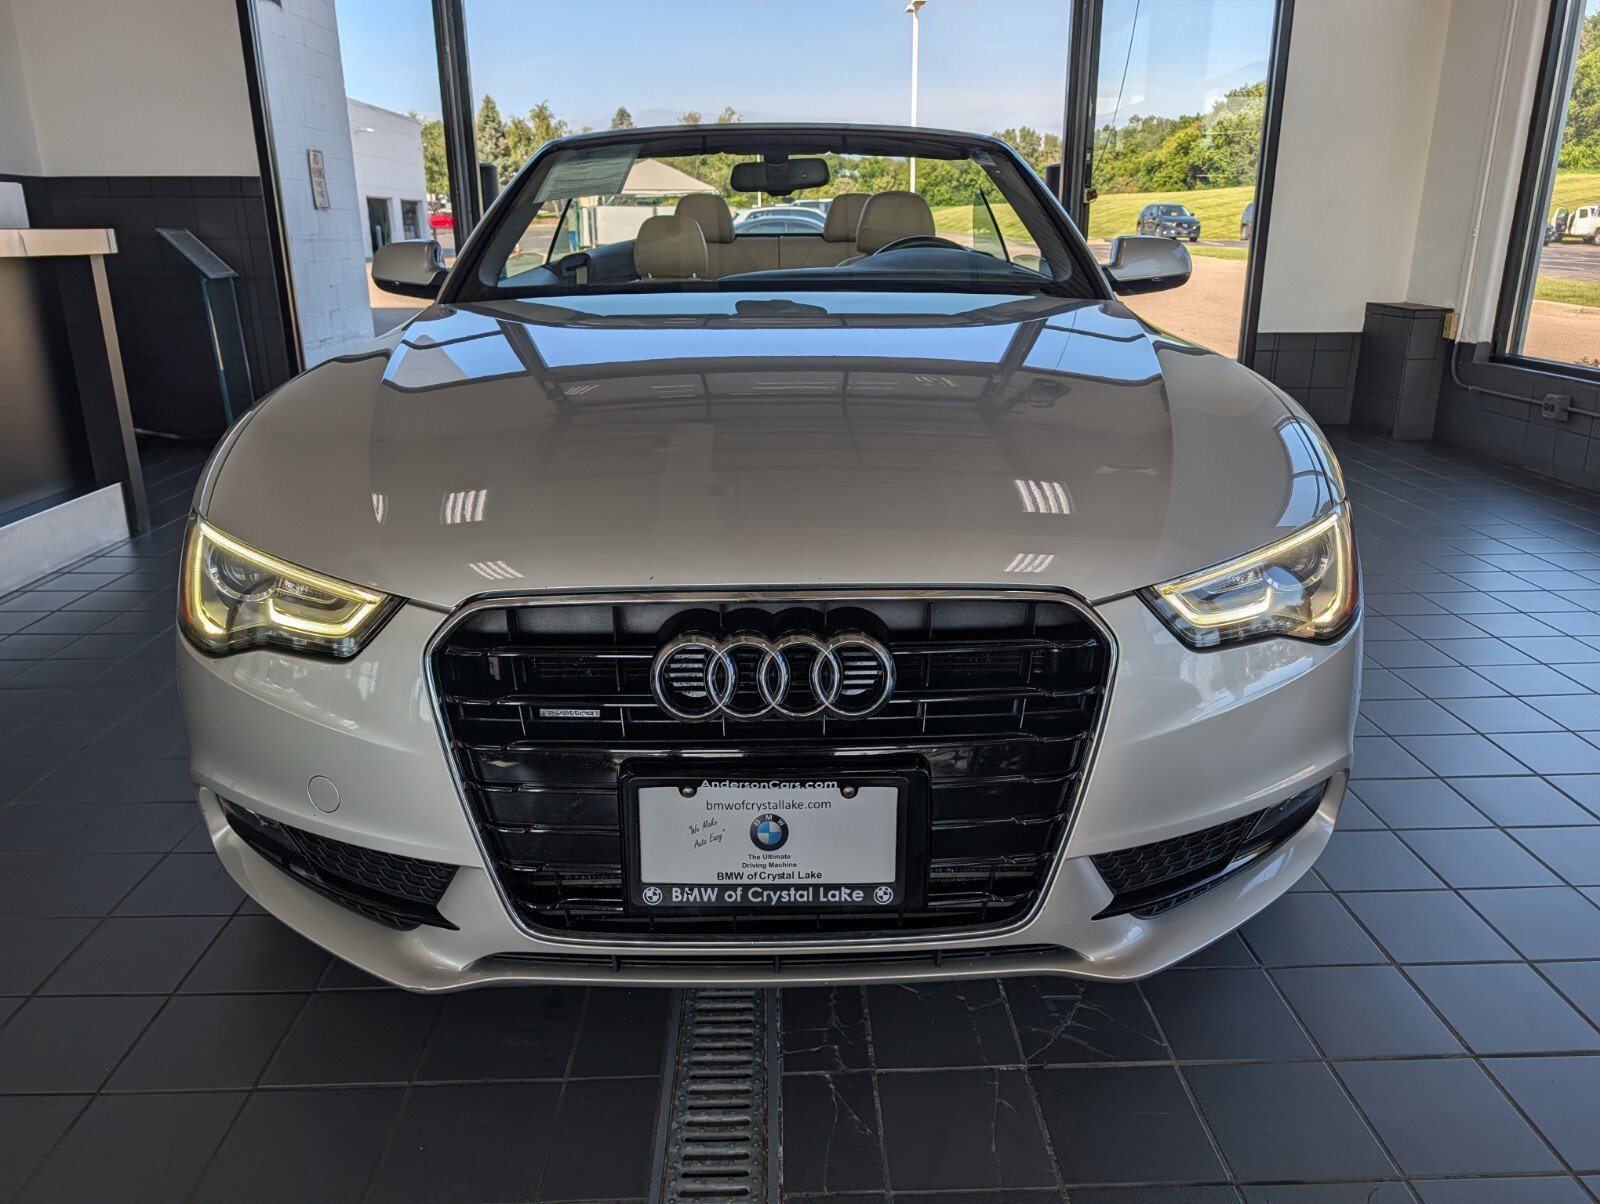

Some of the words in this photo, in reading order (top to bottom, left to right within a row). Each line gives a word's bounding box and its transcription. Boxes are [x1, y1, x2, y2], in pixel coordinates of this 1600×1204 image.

[701, 780, 837, 789] AndersonCars.com
[706, 800, 832, 811] bmwofcrystallake.com
[717, 872, 744, 880] BMW
[747, 872, 758, 880] of
[759, 871, 794, 881] Crystal
[798, 871, 822, 879] Lake
[671, 887, 718, 902] BMW
[724, 887, 742, 902] of
[748, 887, 813, 905] Crystal
[820, 887, 864, 902] Lake
